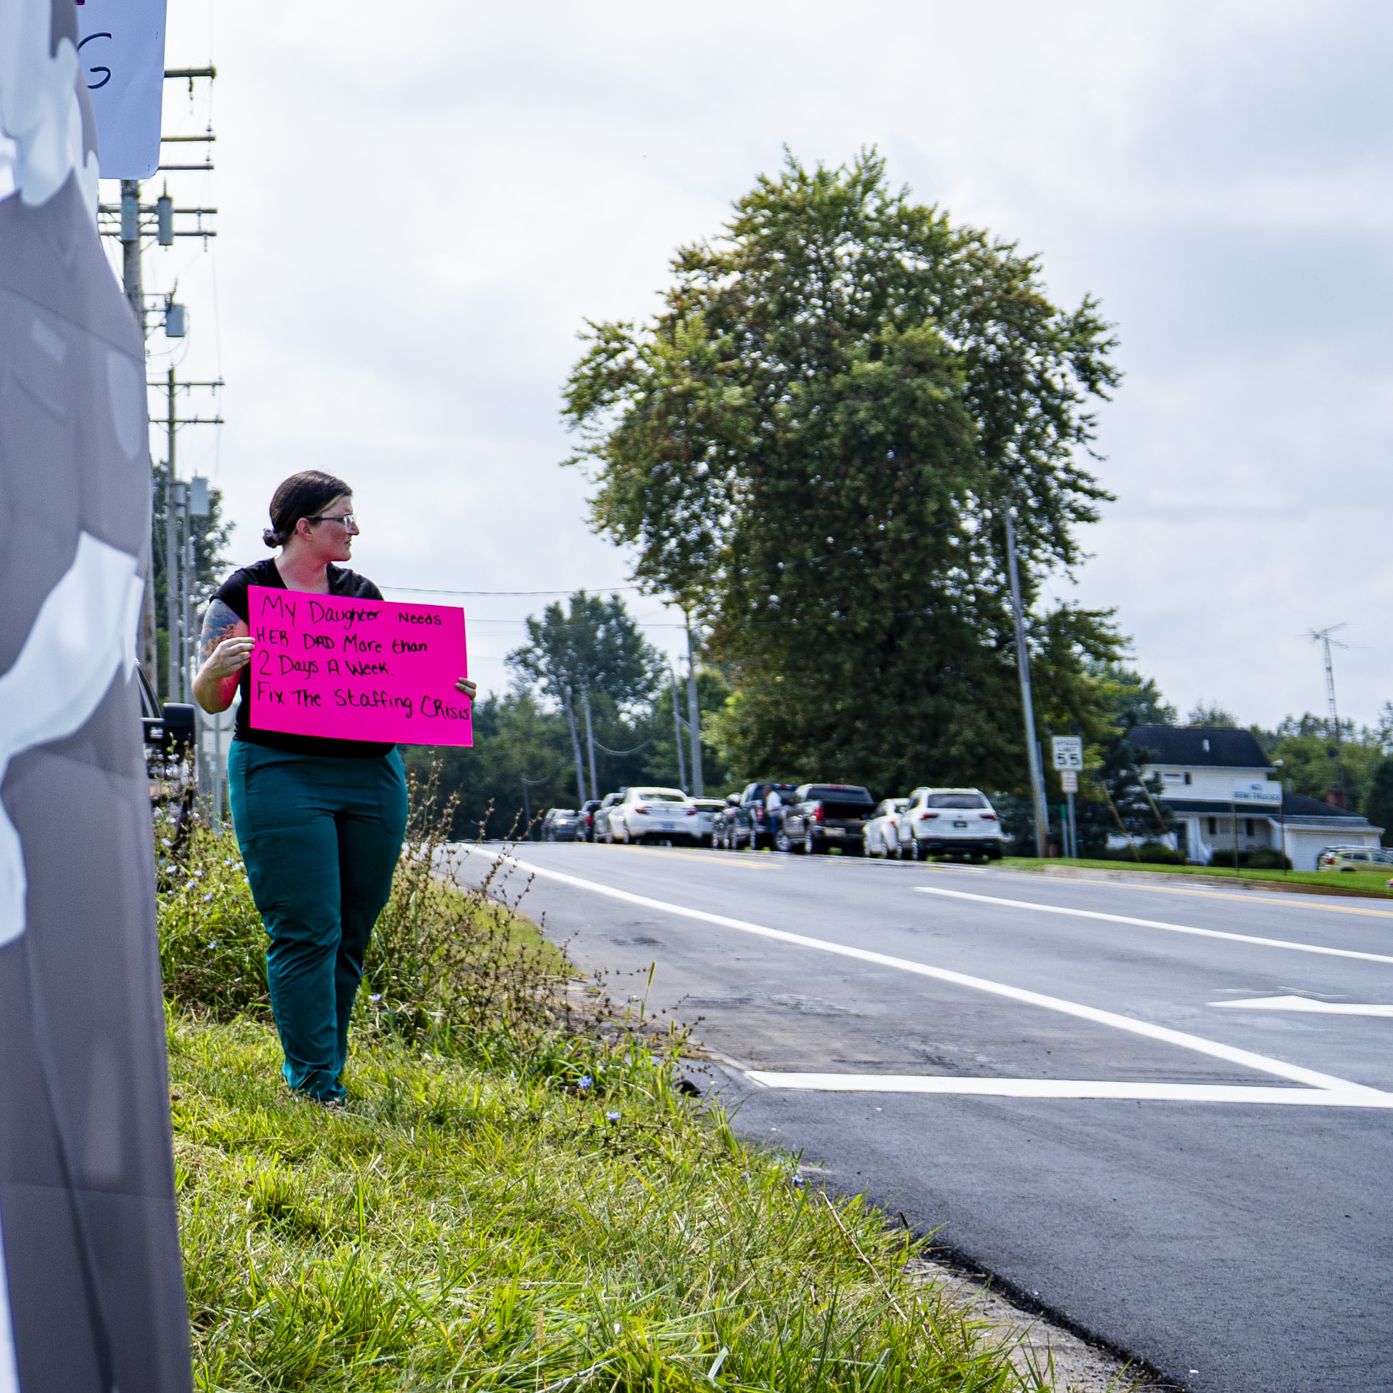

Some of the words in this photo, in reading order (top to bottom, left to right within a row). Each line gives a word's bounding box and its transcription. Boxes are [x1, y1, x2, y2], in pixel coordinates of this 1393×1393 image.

[308, 600, 381, 631] Daughter
[256, 626, 289, 646] HER
[302, 633, 335, 650] DAD
[343, 633, 382, 653] More
[392, 638, 428, 654] than
[257, 649, 272, 676] 2
[278, 654, 319, 680] Days
[327, 659, 341, 676] A
[257, 680, 285, 705] Fix
[290, 688, 322, 708] The
[334, 688, 413, 719] Staffing
[1057, 752, 1080, 766] 55
